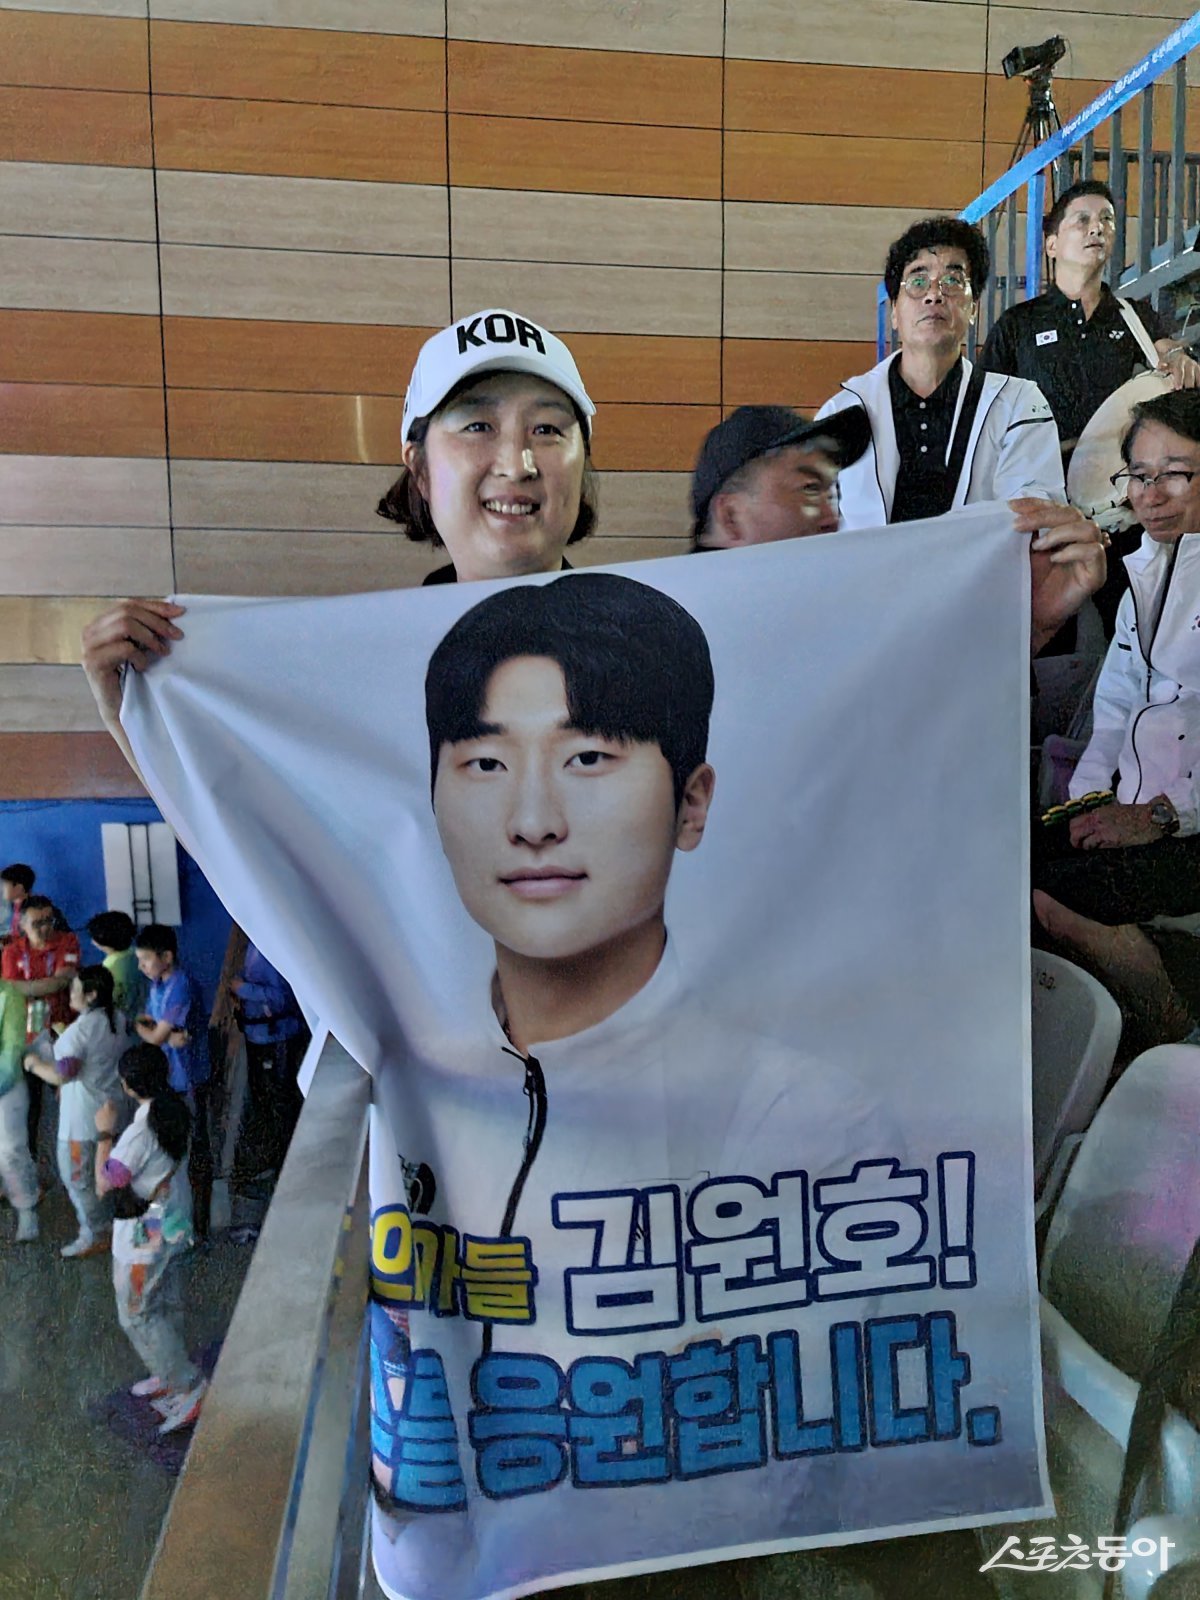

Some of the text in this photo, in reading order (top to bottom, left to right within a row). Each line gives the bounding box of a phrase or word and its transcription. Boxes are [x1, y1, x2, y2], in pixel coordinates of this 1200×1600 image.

[456, 313, 546, 355] KOR
[550, 1150, 977, 1337] 김원호!
[466, 1309, 1002, 1501] 응원합니다.
